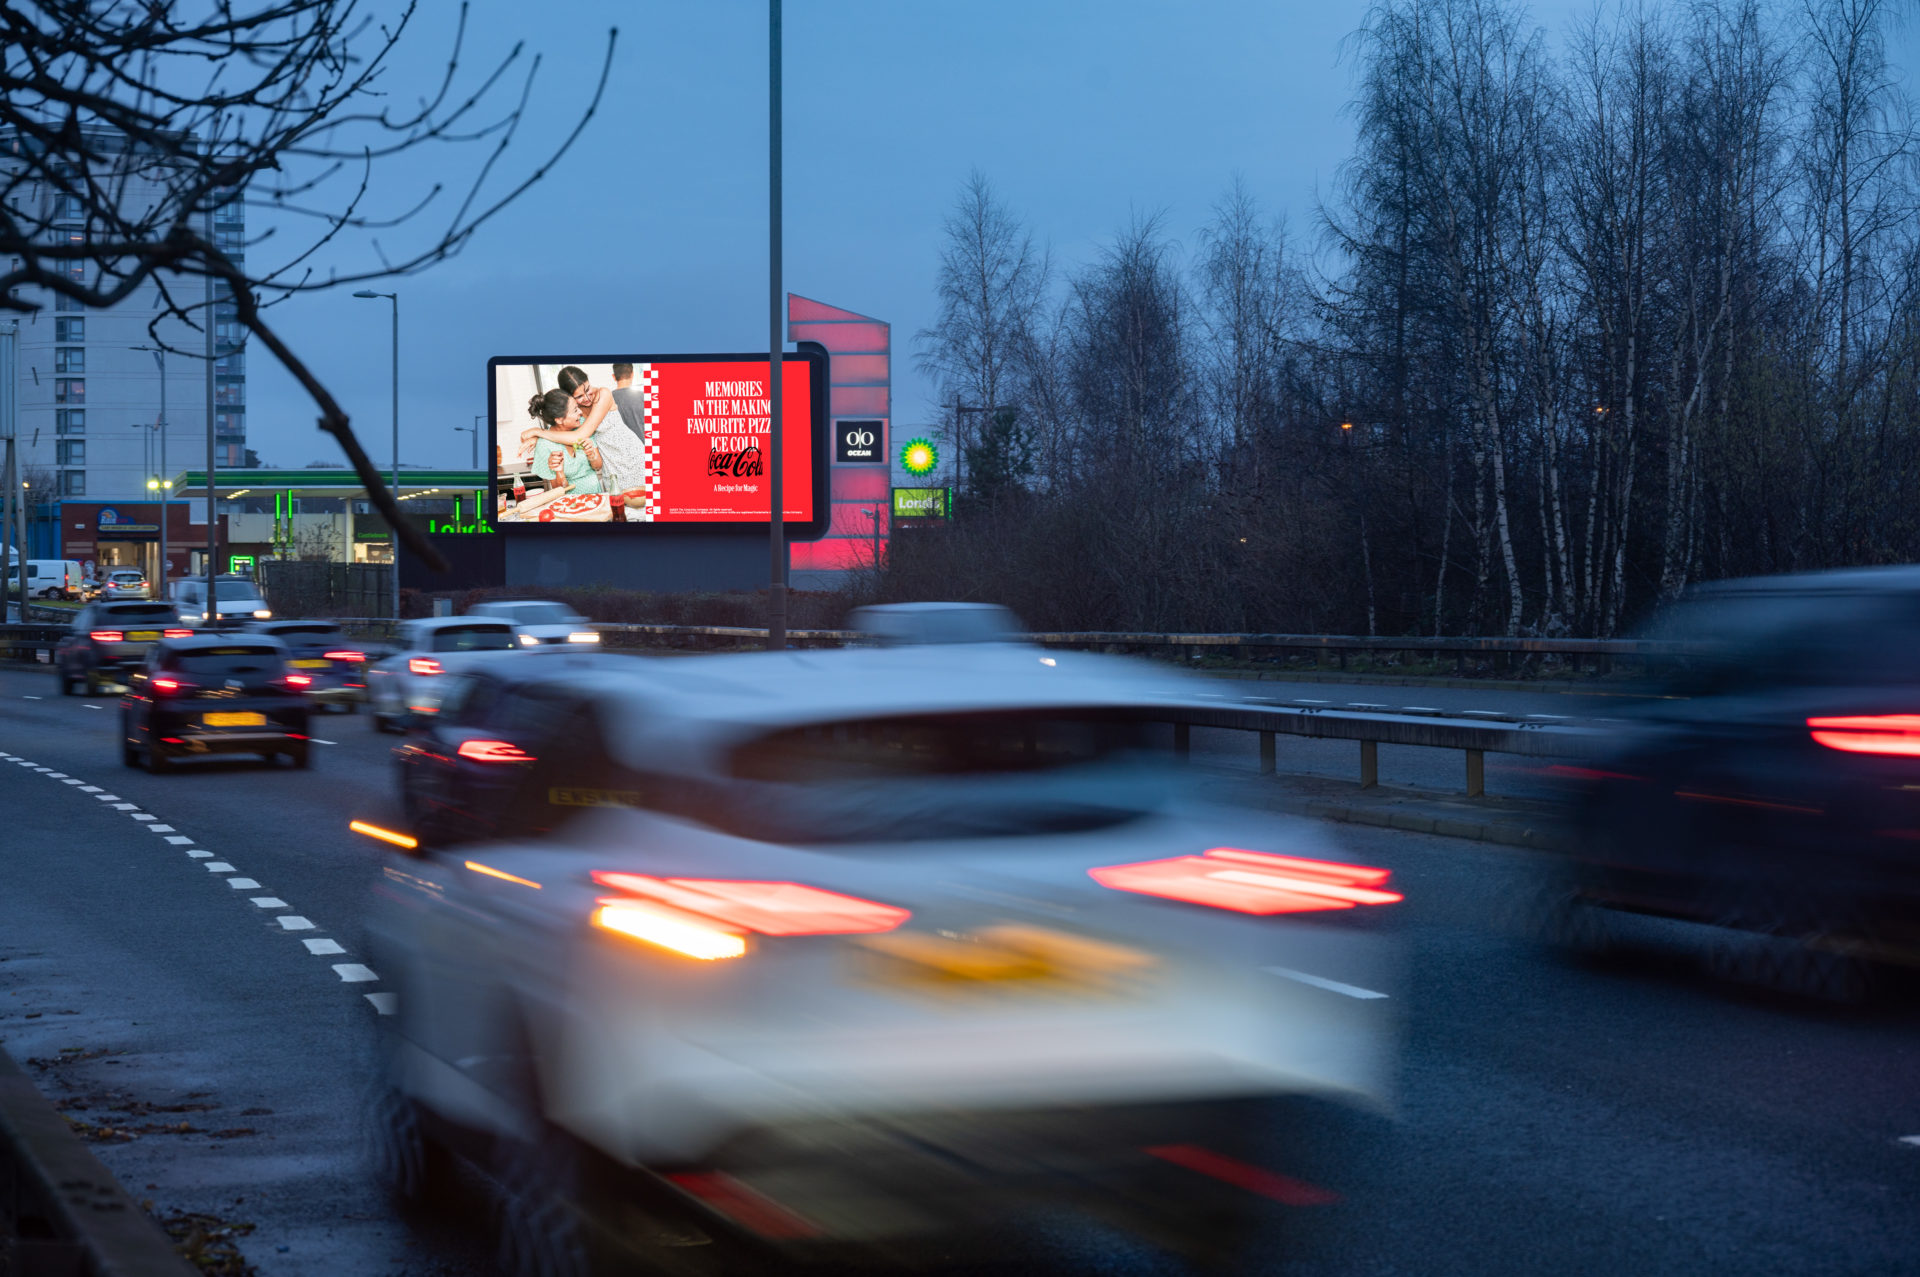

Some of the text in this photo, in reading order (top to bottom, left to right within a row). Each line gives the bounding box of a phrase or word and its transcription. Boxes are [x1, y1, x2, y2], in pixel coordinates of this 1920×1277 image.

[705, 381, 763, 397] MEMORIES
[693, 399, 705, 416] IN
[706, 399, 729, 416] THE
[687, 418, 772, 434] FAVOURITE PIZZ
[711, 436, 759, 452] ICE COLD
[718, 484, 735, 494] Recipe
[735, 484, 743, 492] for
[743, 484, 758, 494] Magic
